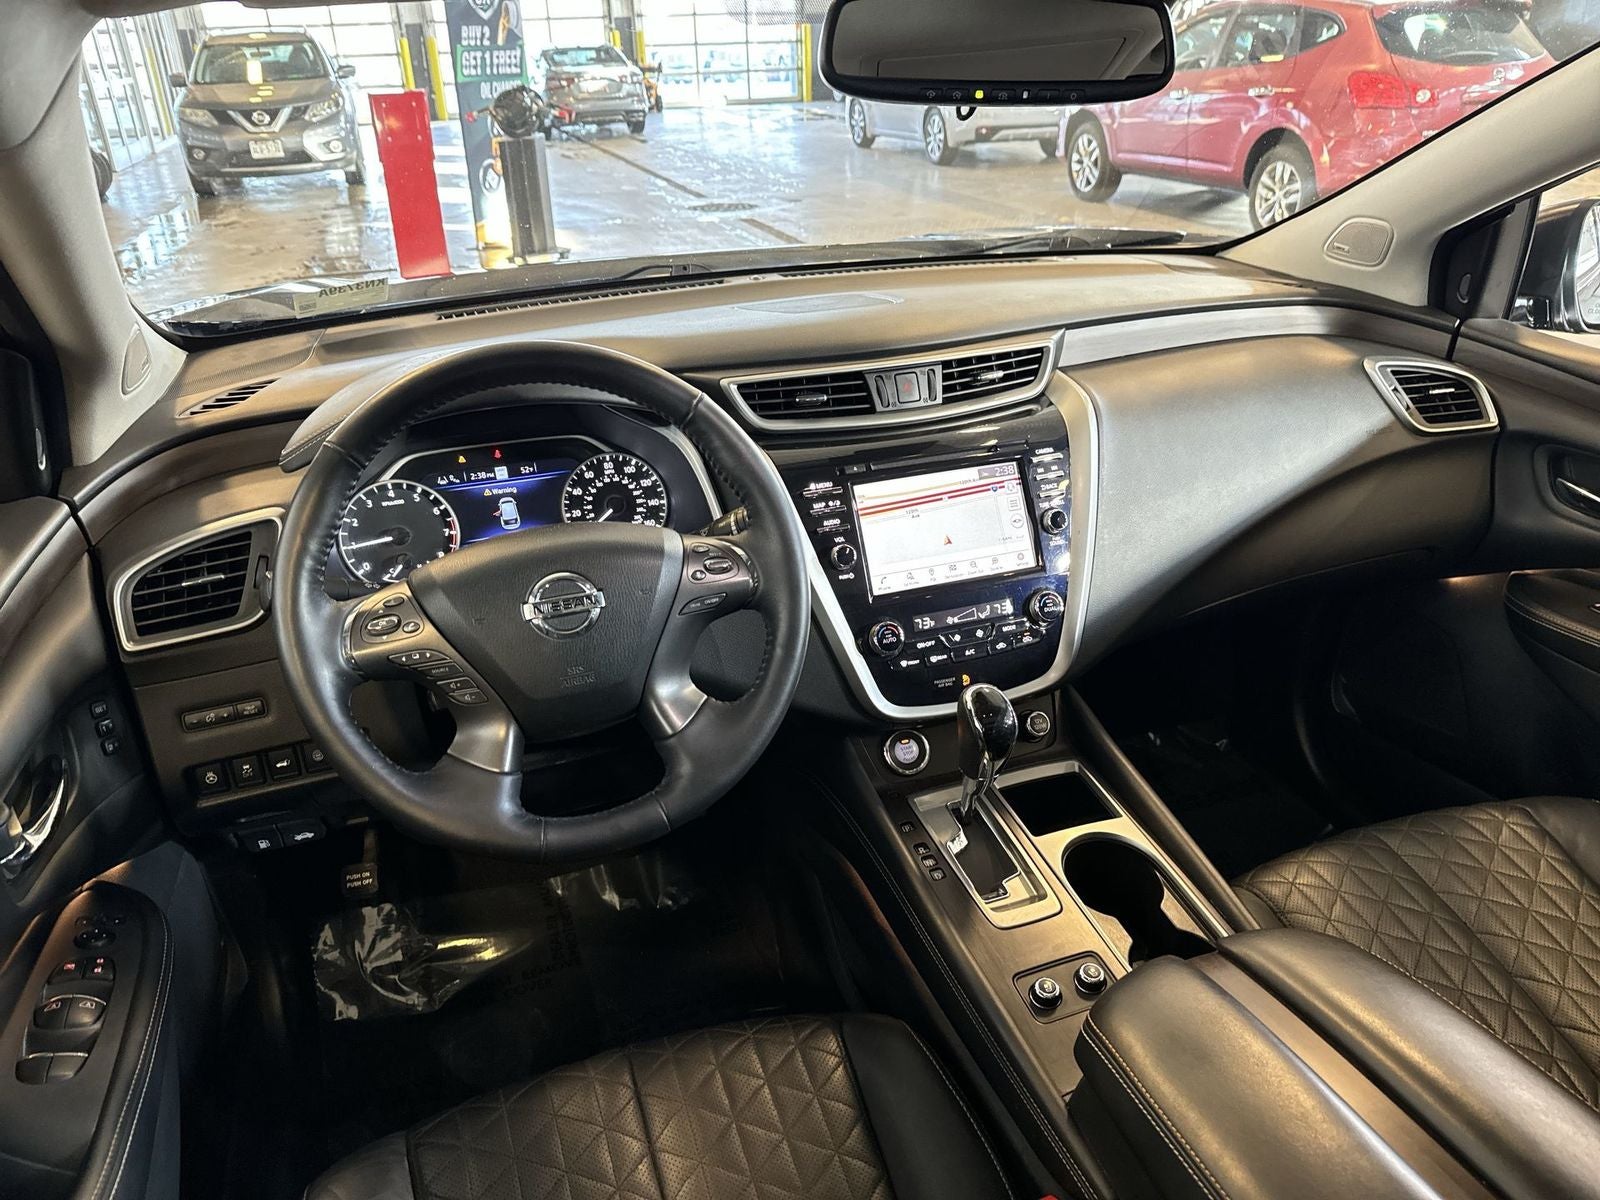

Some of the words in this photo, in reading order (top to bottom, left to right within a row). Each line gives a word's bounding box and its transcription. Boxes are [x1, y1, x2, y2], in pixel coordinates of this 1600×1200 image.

[461, 25, 482, 46] BUY
[482, 25, 491, 46] 2
[461, 50, 482, 76] GET
[484, 50, 491, 75] 1
[492, 46, 521, 75] FREE!
[994, 464, 1015, 476] 2:38
[584, 471, 595, 479] 60
[640, 479, 652, 487] 120
[387, 490, 395, 498] 4
[492, 486, 517, 495] Warning
[572, 488, 583, 496] 40
[413, 493, 420, 502] 5
[366, 499, 373, 508] 3
[647, 498, 660, 507] 140
[432, 507, 441, 516] 6
[571, 509, 582, 518] 20
[351, 518, 359, 527] 2
[823, 518, 841, 527] AUDIO
[442, 528, 450, 537] 7
[362, 562, 371, 571] 0
[533, 594, 599, 615] NISSAN
[1002, 624, 1017, 632] MODE
[346, 873, 361, 881] PUSH
[346, 880, 362, 889] PUSH
